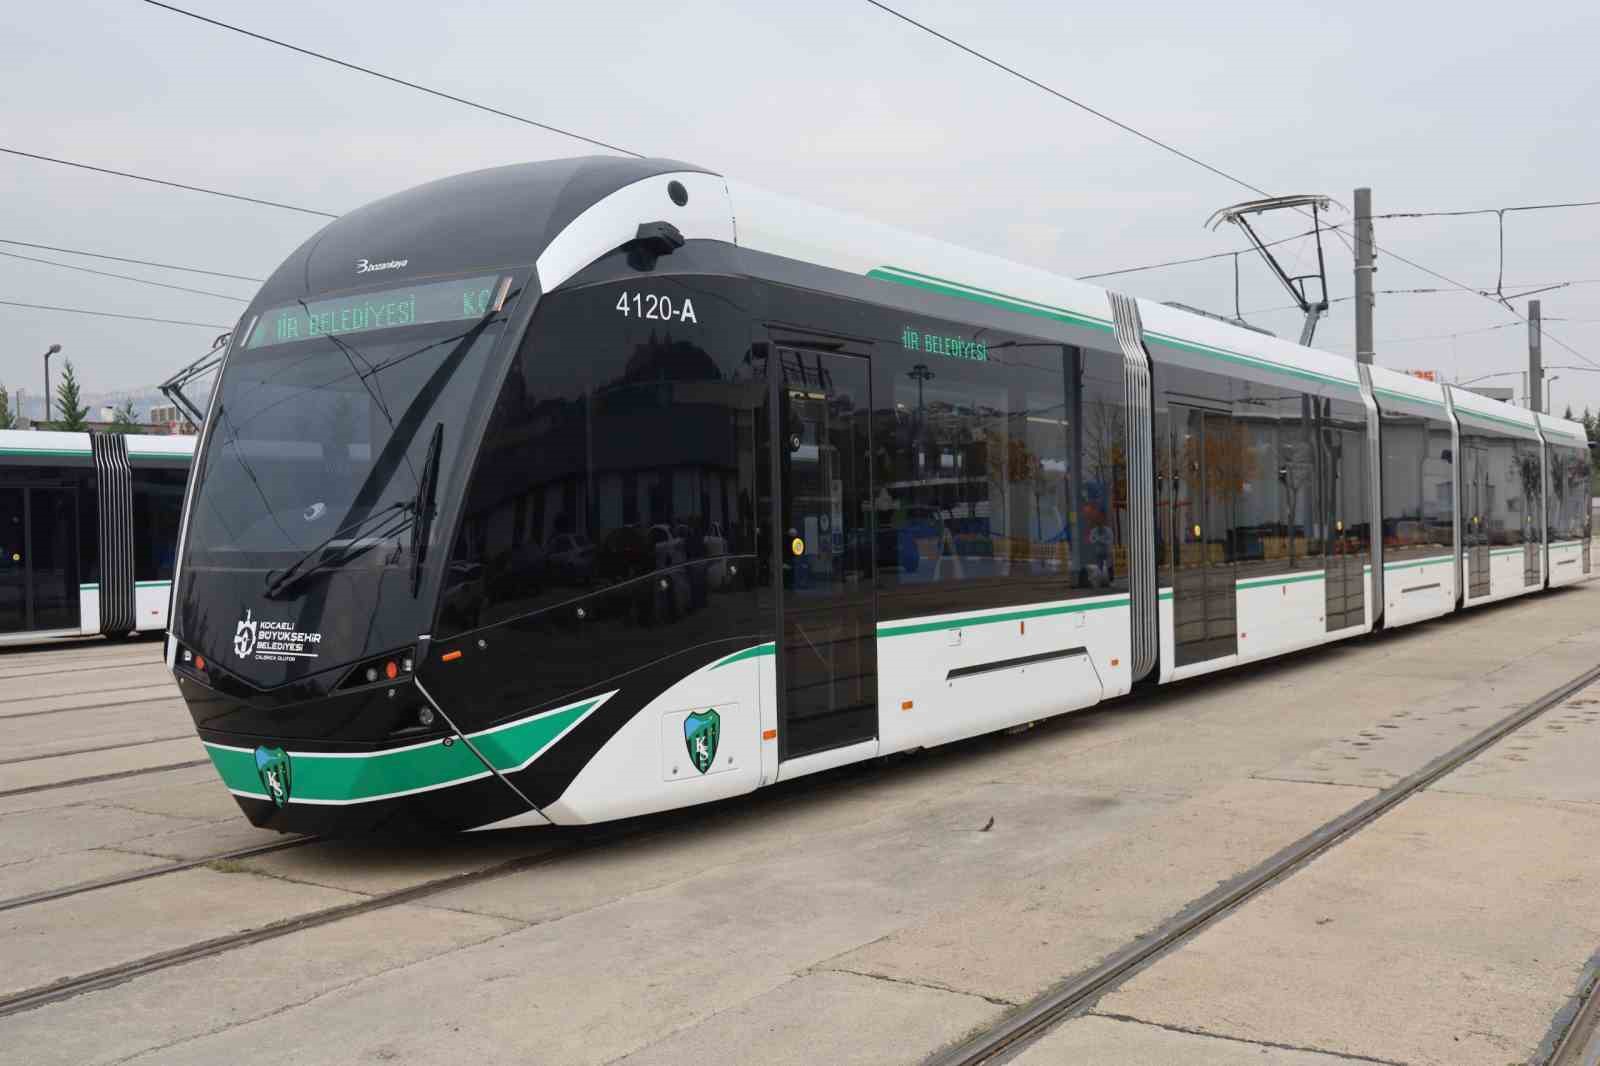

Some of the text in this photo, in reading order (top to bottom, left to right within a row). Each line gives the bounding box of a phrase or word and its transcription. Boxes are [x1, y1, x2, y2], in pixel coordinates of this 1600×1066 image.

[310, 293, 416, 337] BELEDİYESİ
[616, 291, 697, 324] 4120-A
[925, 333, 987, 361] BELEDİYESİ
